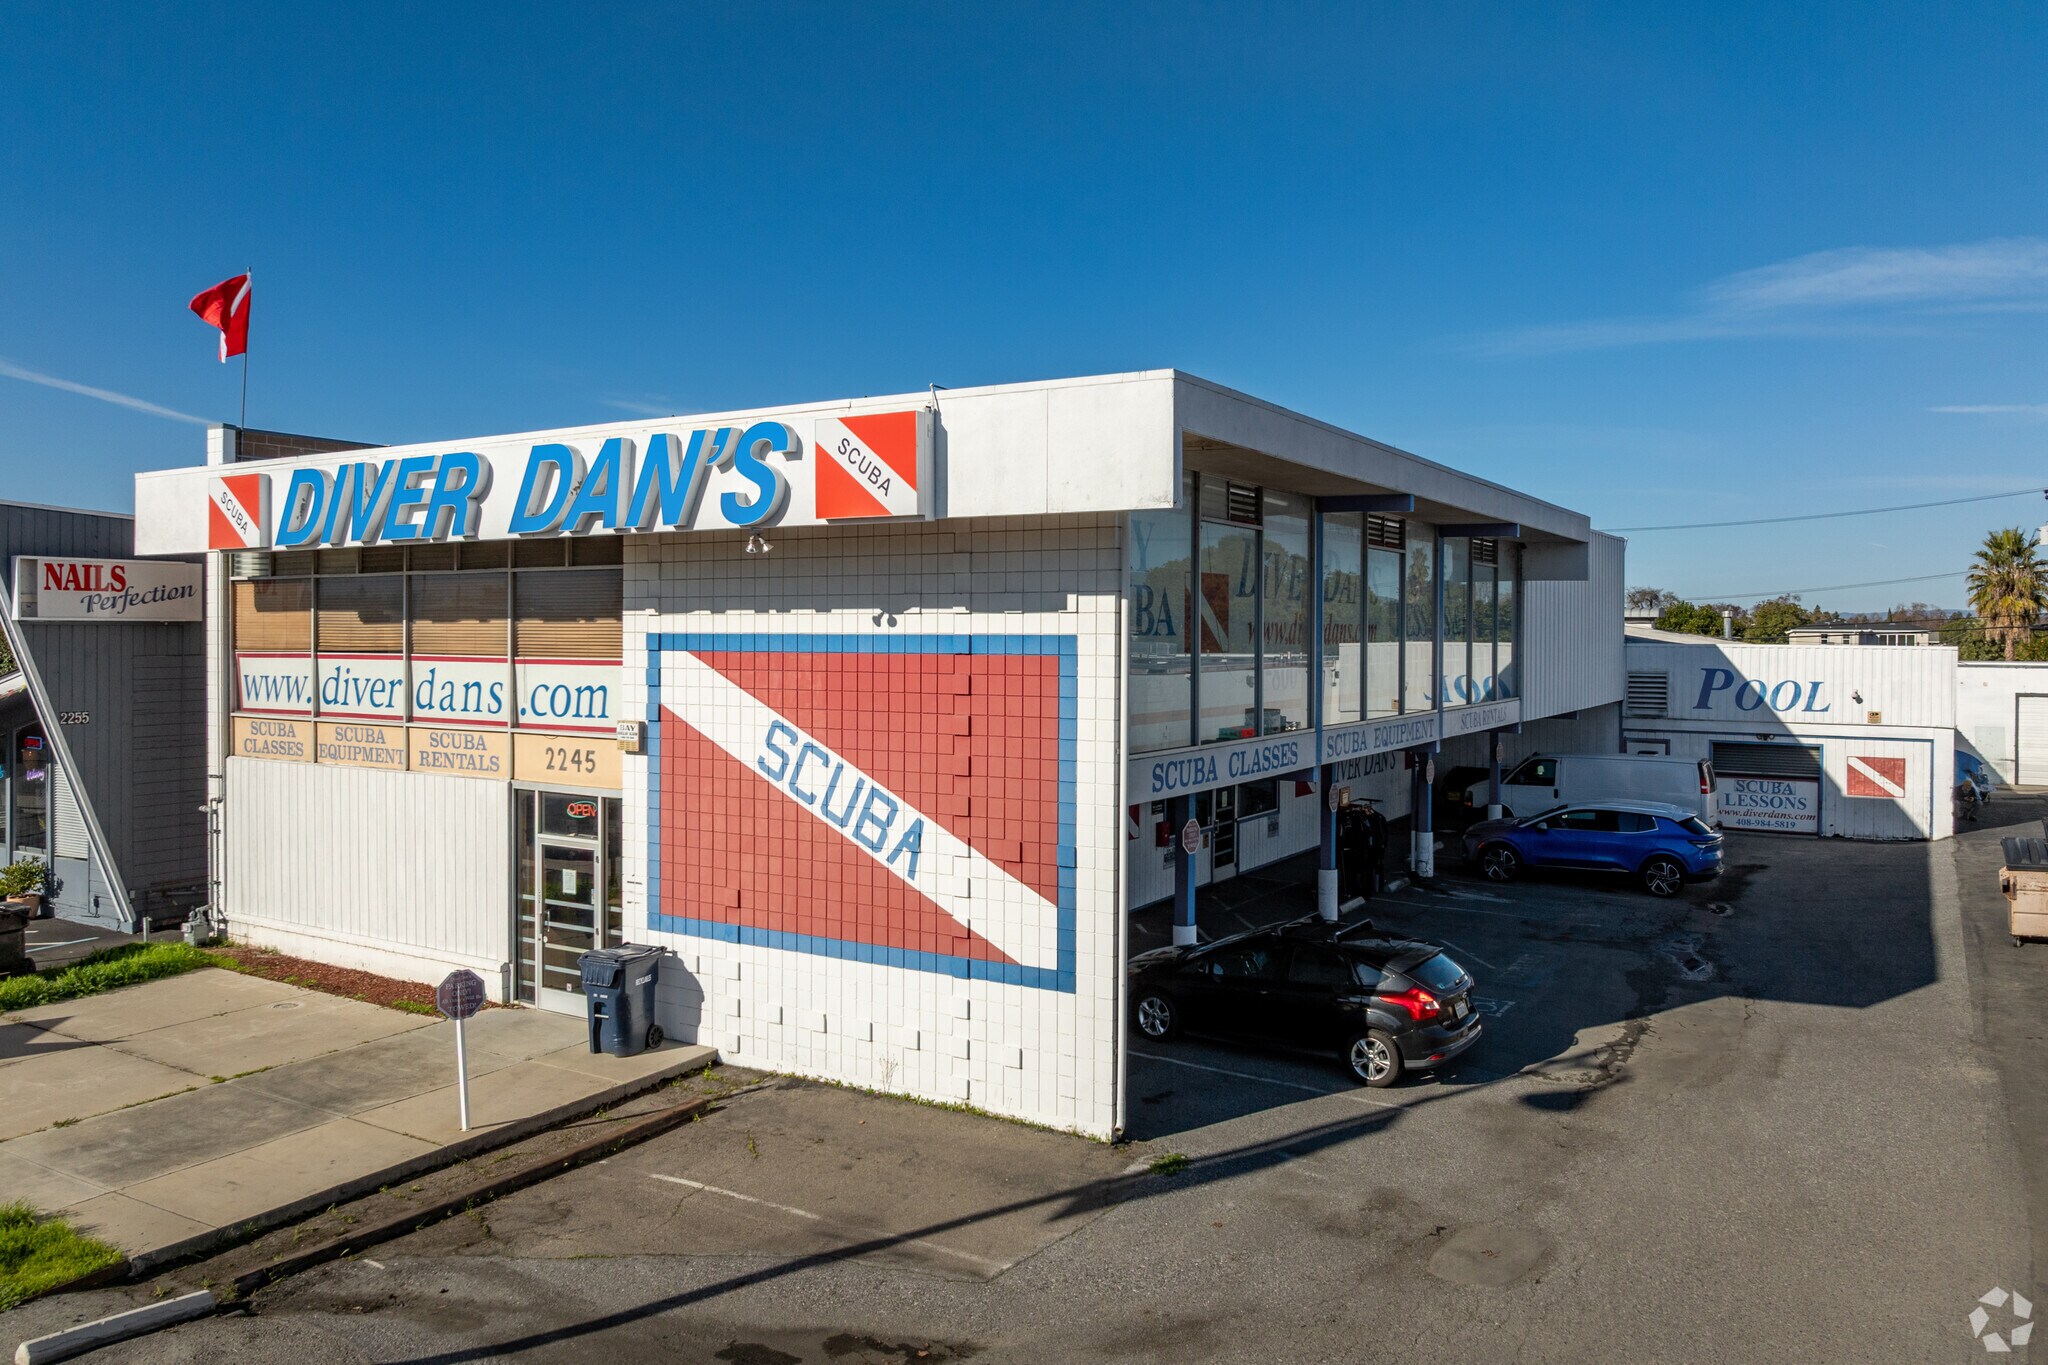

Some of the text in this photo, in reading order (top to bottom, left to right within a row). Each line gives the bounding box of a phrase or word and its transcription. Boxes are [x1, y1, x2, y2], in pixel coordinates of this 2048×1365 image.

[837, 437, 892, 498] SCUBA
[275, 420, 797, 547] DIVER DAN'S
[220, 490, 249, 535] SCUBA
[44, 563, 127, 592] NAILS
[80, 585, 197, 615] Perfection
[1692, 668, 1832, 712] POOL
[60, 711, 90, 725] 2255
[250, 721, 296, 738] SCUBA
[1461, 706, 1507, 730] SCUBA RENTALS
[335, 726, 386, 744] SCUBA
[429, 732, 488, 751] SCUBA
[1326, 719, 1435, 758] SCUBA EQUIPMENT
[244, 738, 304, 757] CLASSES
[318, 743, 404, 765] EQUIPMENT
[418, 750, 501, 773] RENTALS
[545, 747, 596, 774] 2245
[1151, 742, 1298, 793] SCUBA CLASSES
[1335, 757, 1362, 783] IVER
[757, 719, 925, 881] SCUBA
[1735, 780, 1794, 796] SCUBA
[568, 803, 597, 817] OPEN
[1724, 793, 1807, 811] LESSONS
[1735, 818, 1796, 829] 408-984-5819
